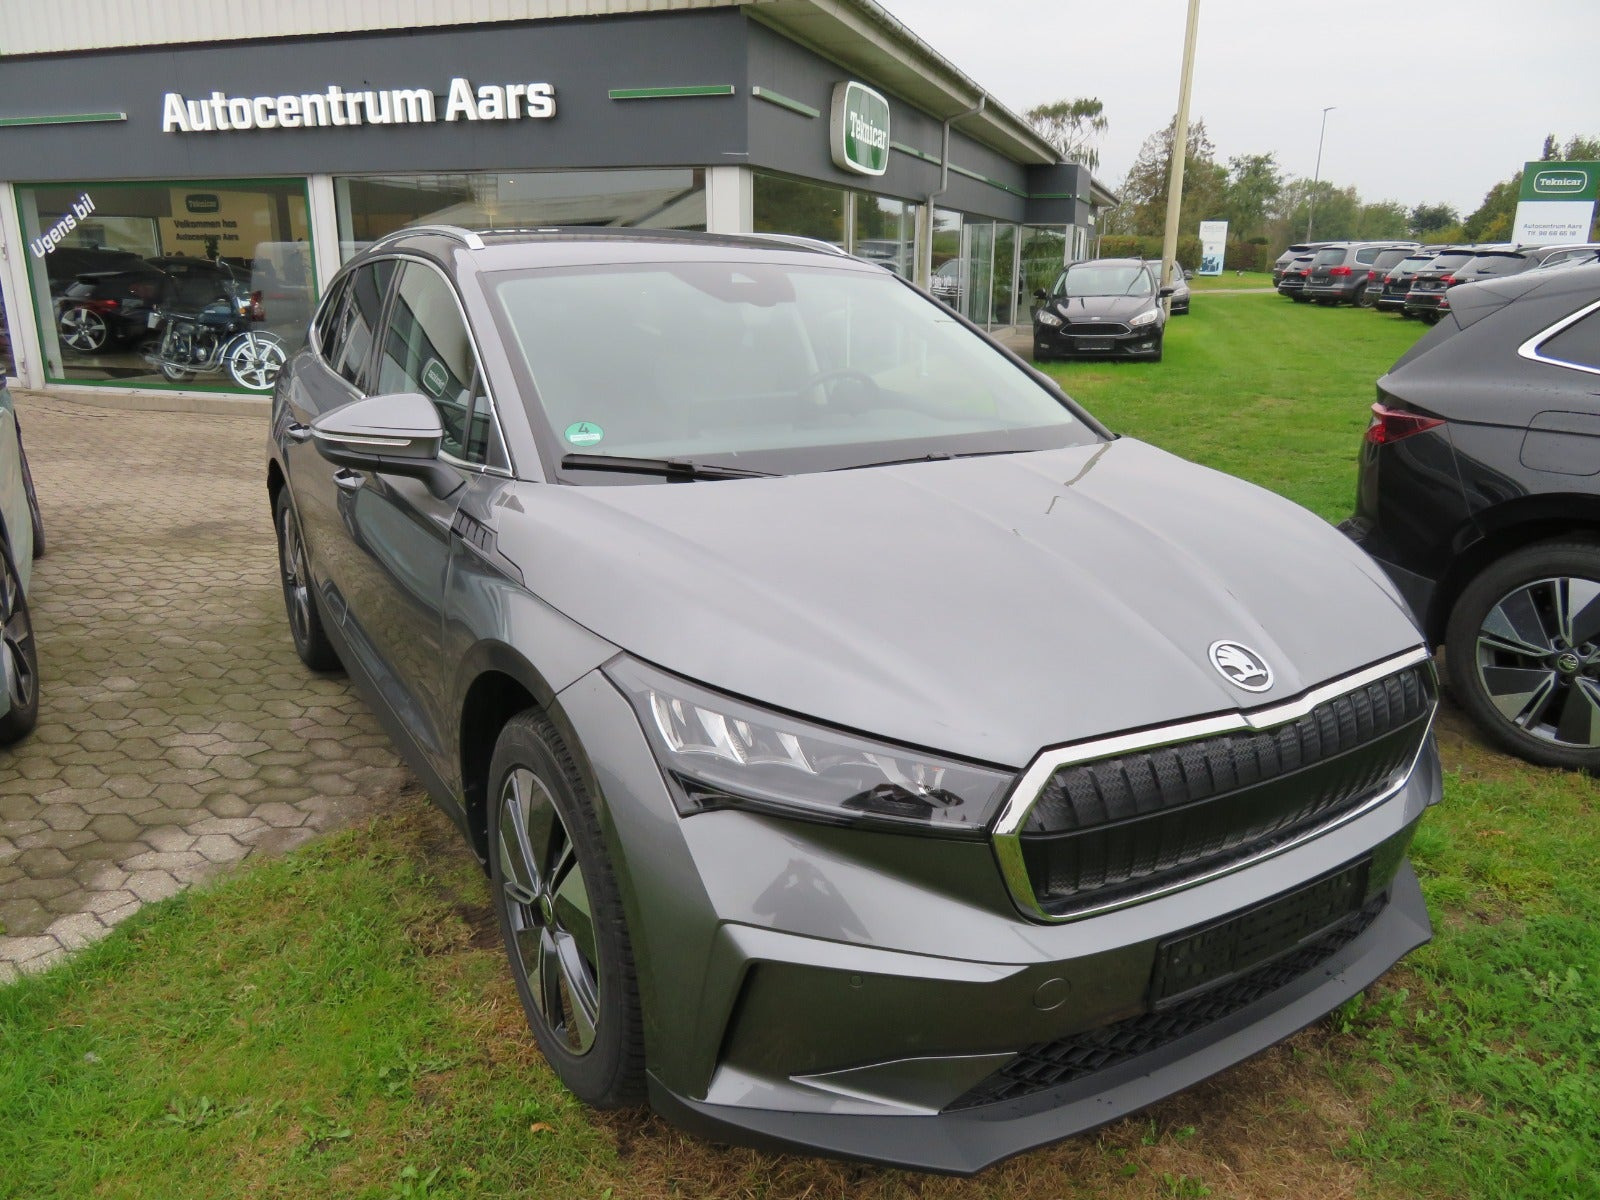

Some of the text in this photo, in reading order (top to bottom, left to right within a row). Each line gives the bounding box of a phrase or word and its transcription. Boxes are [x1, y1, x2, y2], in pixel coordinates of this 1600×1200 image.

[162, 77, 557, 133] Autocentrum Aars
[850, 111, 887, 150] Teknicar
[1540, 178, 1582, 186] Teknicar
[30, 193, 96, 258] Ugens bil
[578, 422, 590, 434] 4
